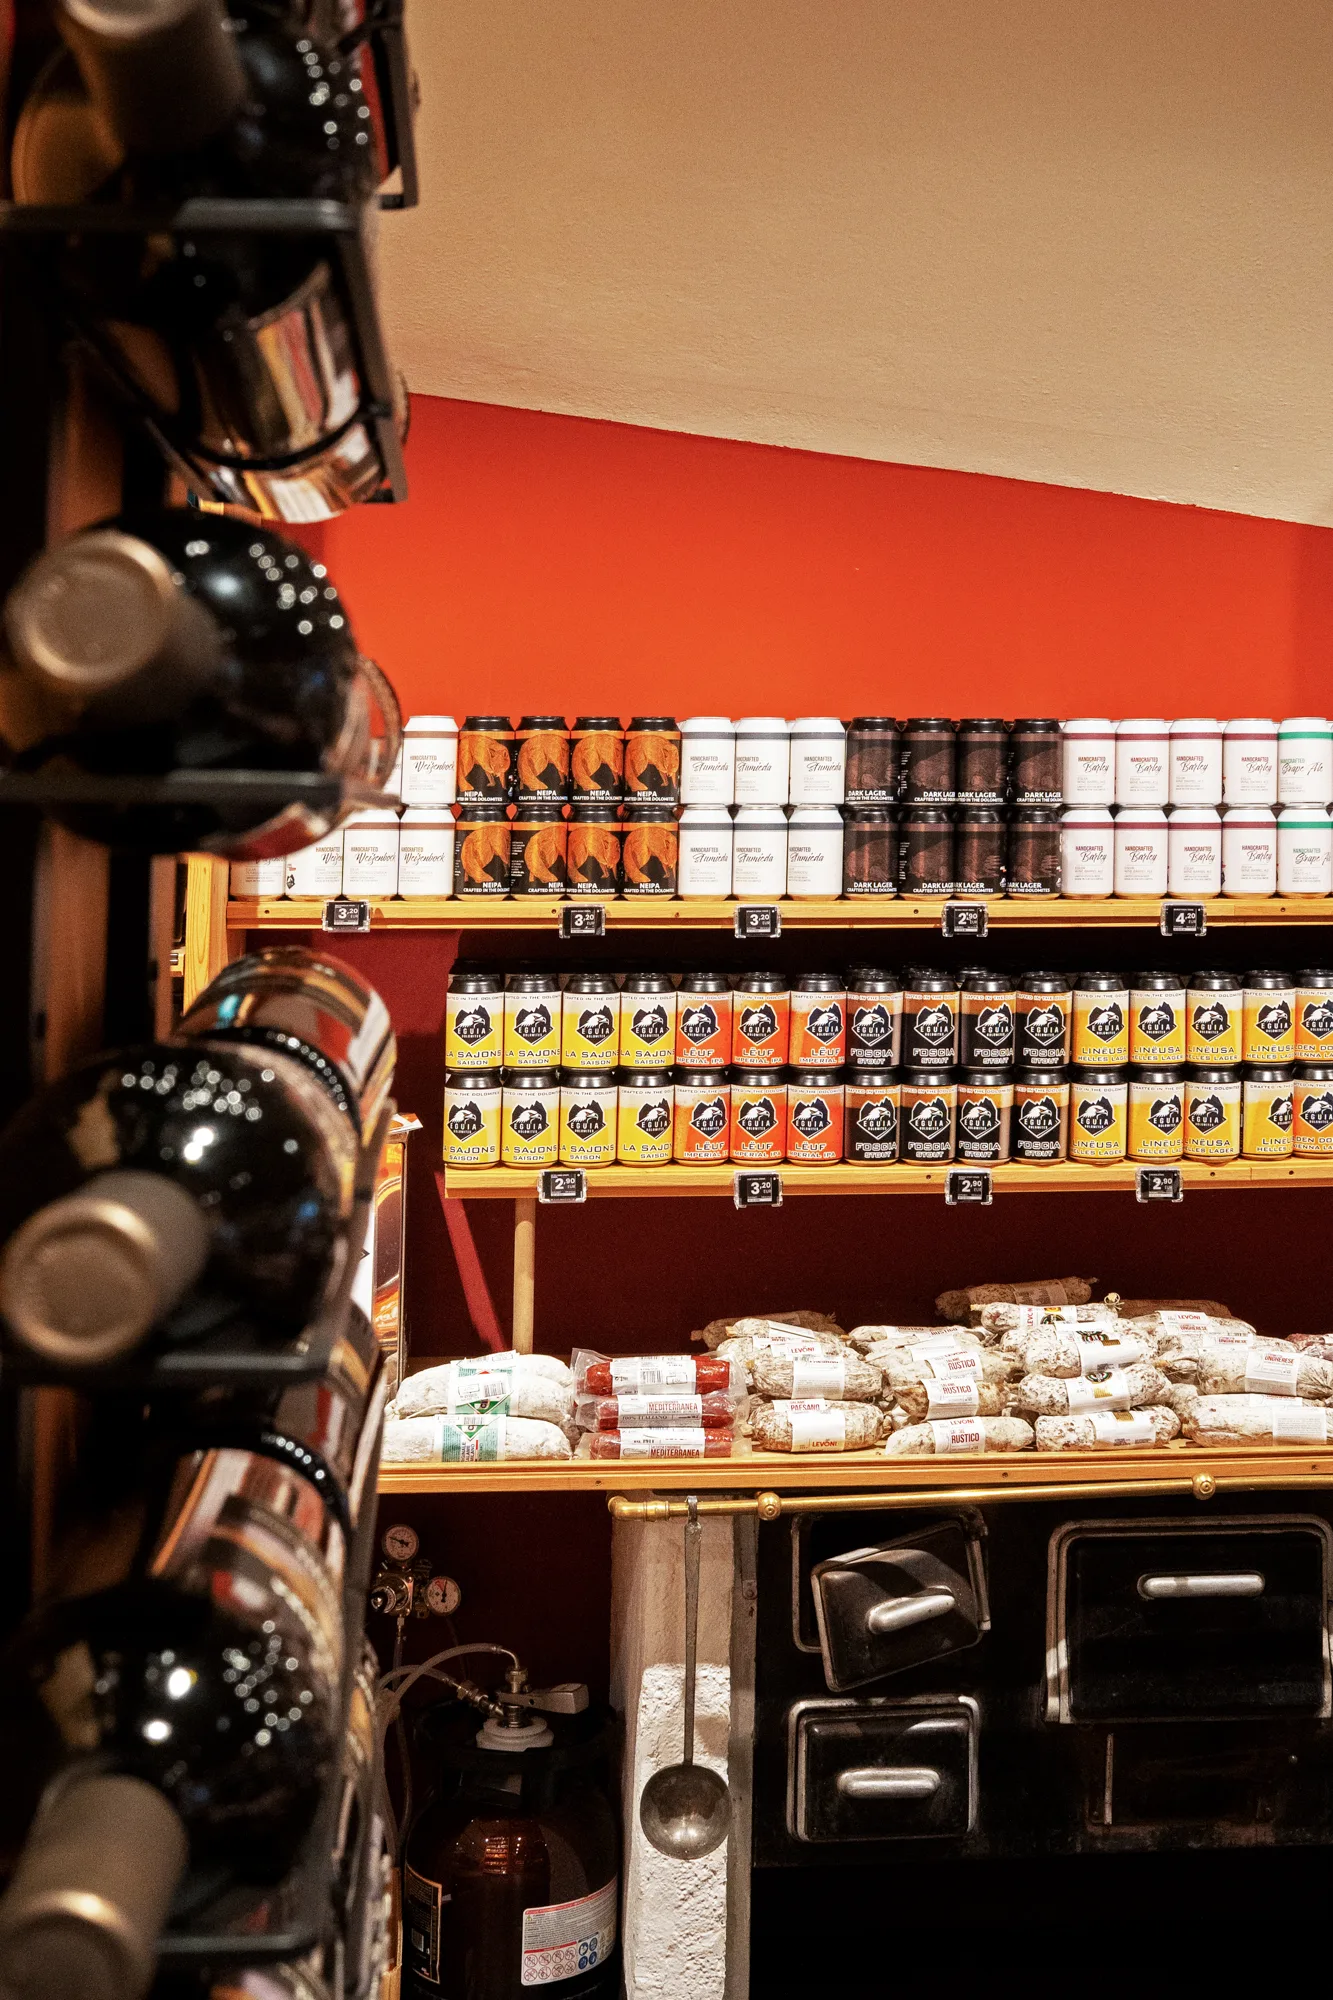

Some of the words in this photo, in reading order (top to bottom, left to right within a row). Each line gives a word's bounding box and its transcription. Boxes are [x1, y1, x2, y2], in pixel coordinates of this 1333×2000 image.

[1083, 762, 1109, 773] Barley
[1135, 762, 1162, 773] Barley
[1180, 761, 1209, 773] Barley
[1246, 762, 1272, 773] Barley
[1281, 762, 1304, 775] Grape
[1080, 851, 1107, 863] Barley
[1129, 851, 1157, 863] Barley
[1189, 851, 1215, 863] Barley
[1246, 850, 1272, 862] Barley
[1295, 852, 1320, 864] Grape
[338, 908, 358, 919] 3,20
[1176, 912, 1196, 924] 4,20
[575, 914, 594, 926] 3,20
[750, 914, 770, 925] 3,20
[850, 1049, 893, 1057] FOSCIA
[913, 1047, 955, 1057] FOSCIA
[974, 1048, 1013, 1057] FOSCIA
[1023, 1047, 1066, 1057] FOSCIA
[514, 1145, 557, 1153] SAJONS
[570, 1144, 614, 1153] SAJONS
[856, 1142, 897, 1151] FOSCIA
[908, 1141, 951, 1150] FOSCIA
[959, 1140, 1001, 1150] FOSCIA
[1017, 1140, 1061, 1149] FOSCIA
[555, 1178, 576, 1189] 2,90
[750, 1182, 771, 1194] 3,20
[961, 1180, 982, 1192] 2,90
[1152, 1178, 1172, 1190] 2,90
[948, 1359, 976, 1370] RUSTICO
[1264, 1356, 1295, 1364] UNGHERESE
[943, 1385, 972, 1394] RUSTICO
[790, 1403, 820, 1411] PAESANO
[951, 1432, 980, 1444] RUSTICO
